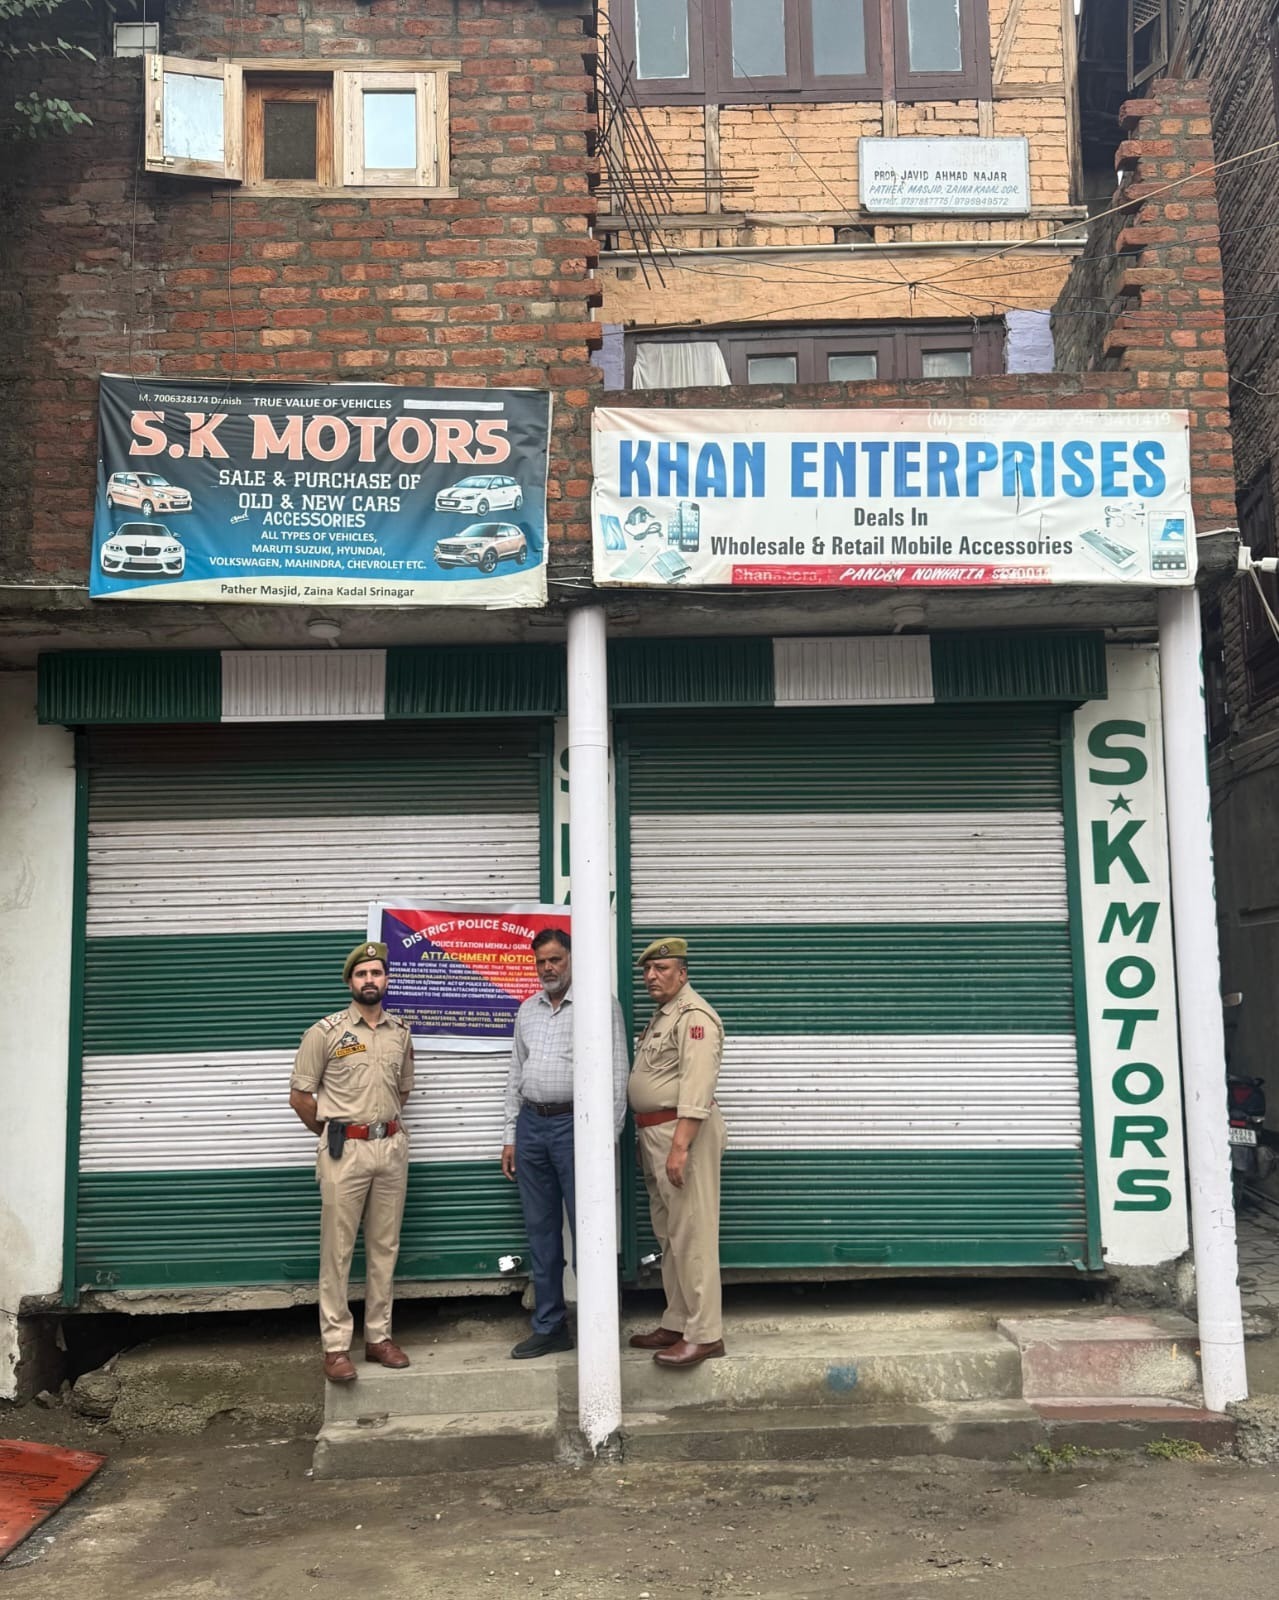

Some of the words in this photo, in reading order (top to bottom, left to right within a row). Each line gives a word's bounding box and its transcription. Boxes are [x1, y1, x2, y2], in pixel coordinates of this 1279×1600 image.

[901, 170, 928, 180] JAVID
[936, 170, 968, 181] AHMAD
[974, 171, 1008, 182] NAJAR
[154, 394, 208, 404] 7006328174
[253, 397, 282, 407] TRUE
[285, 398, 320, 408] VALUE
[323, 398, 338, 408] OF
[342, 398, 392, 410] VEHICLES
[128, 410, 230, 459] S.K
[248, 414, 511, 464] MOTORS
[619, 440, 766, 498] KHAN
[791, 440, 1166, 498] ENTERPRISES
[219, 470, 266, 487] SALE
[272, 471, 287, 487] &
[294, 472, 392, 490] PURCHASE
[398, 474, 422, 490] OF
[238, 492, 273, 510] OLD
[280, 494, 294, 510] &
[302, 495, 346, 512] NEW
[352, 496, 401, 513] CARS
[262, 512, 366, 528] ACCESSORIES
[854, 507, 905, 526] Deals
[912, 507, 928, 526] In
[261, 531, 278, 540] ALL
[280, 532, 310, 542] TYPES
[312, 532, 327, 542] OF
[328, 532, 378, 544] VEHICLES,
[252, 544, 294, 554] MARUTI
[295, 545, 334, 556] SUZUKI,
[336, 546, 386, 558] HYUNDAI,
[710, 536, 805, 556] Wholesale
[812, 536, 826, 556] &
[832, 536, 884, 556] Retail
[892, 536, 952, 556] Mobile
[959, 536, 1073, 556] Accessories
[209, 556, 282, 569] VOLKSWAGEN,
[284, 558, 345, 571] MAHINDRA,
[347, 560, 404, 570] CHEVROLET
[406, 560, 427, 570] ETC.
[220, 584, 258, 596] Pather
[260, 585, 302, 598] Masjid,
[304, 586, 334, 596] Zaina
[336, 586, 368, 597] Kadal
[370, 586, 415, 599] Srinagar
[402, 921, 456, 948] DISTRICT
[458, 919, 500, 930] POLICE
[501, 922, 536, 940] SRINA
[431, 940, 454, 948] POLICE
[455, 941, 484, 949] STATION
[421, 951, 496, 962] ATTACHMENT
[500, 954, 536, 963] NOTIC
[1098, 902, 1172, 1212] MOTORS
